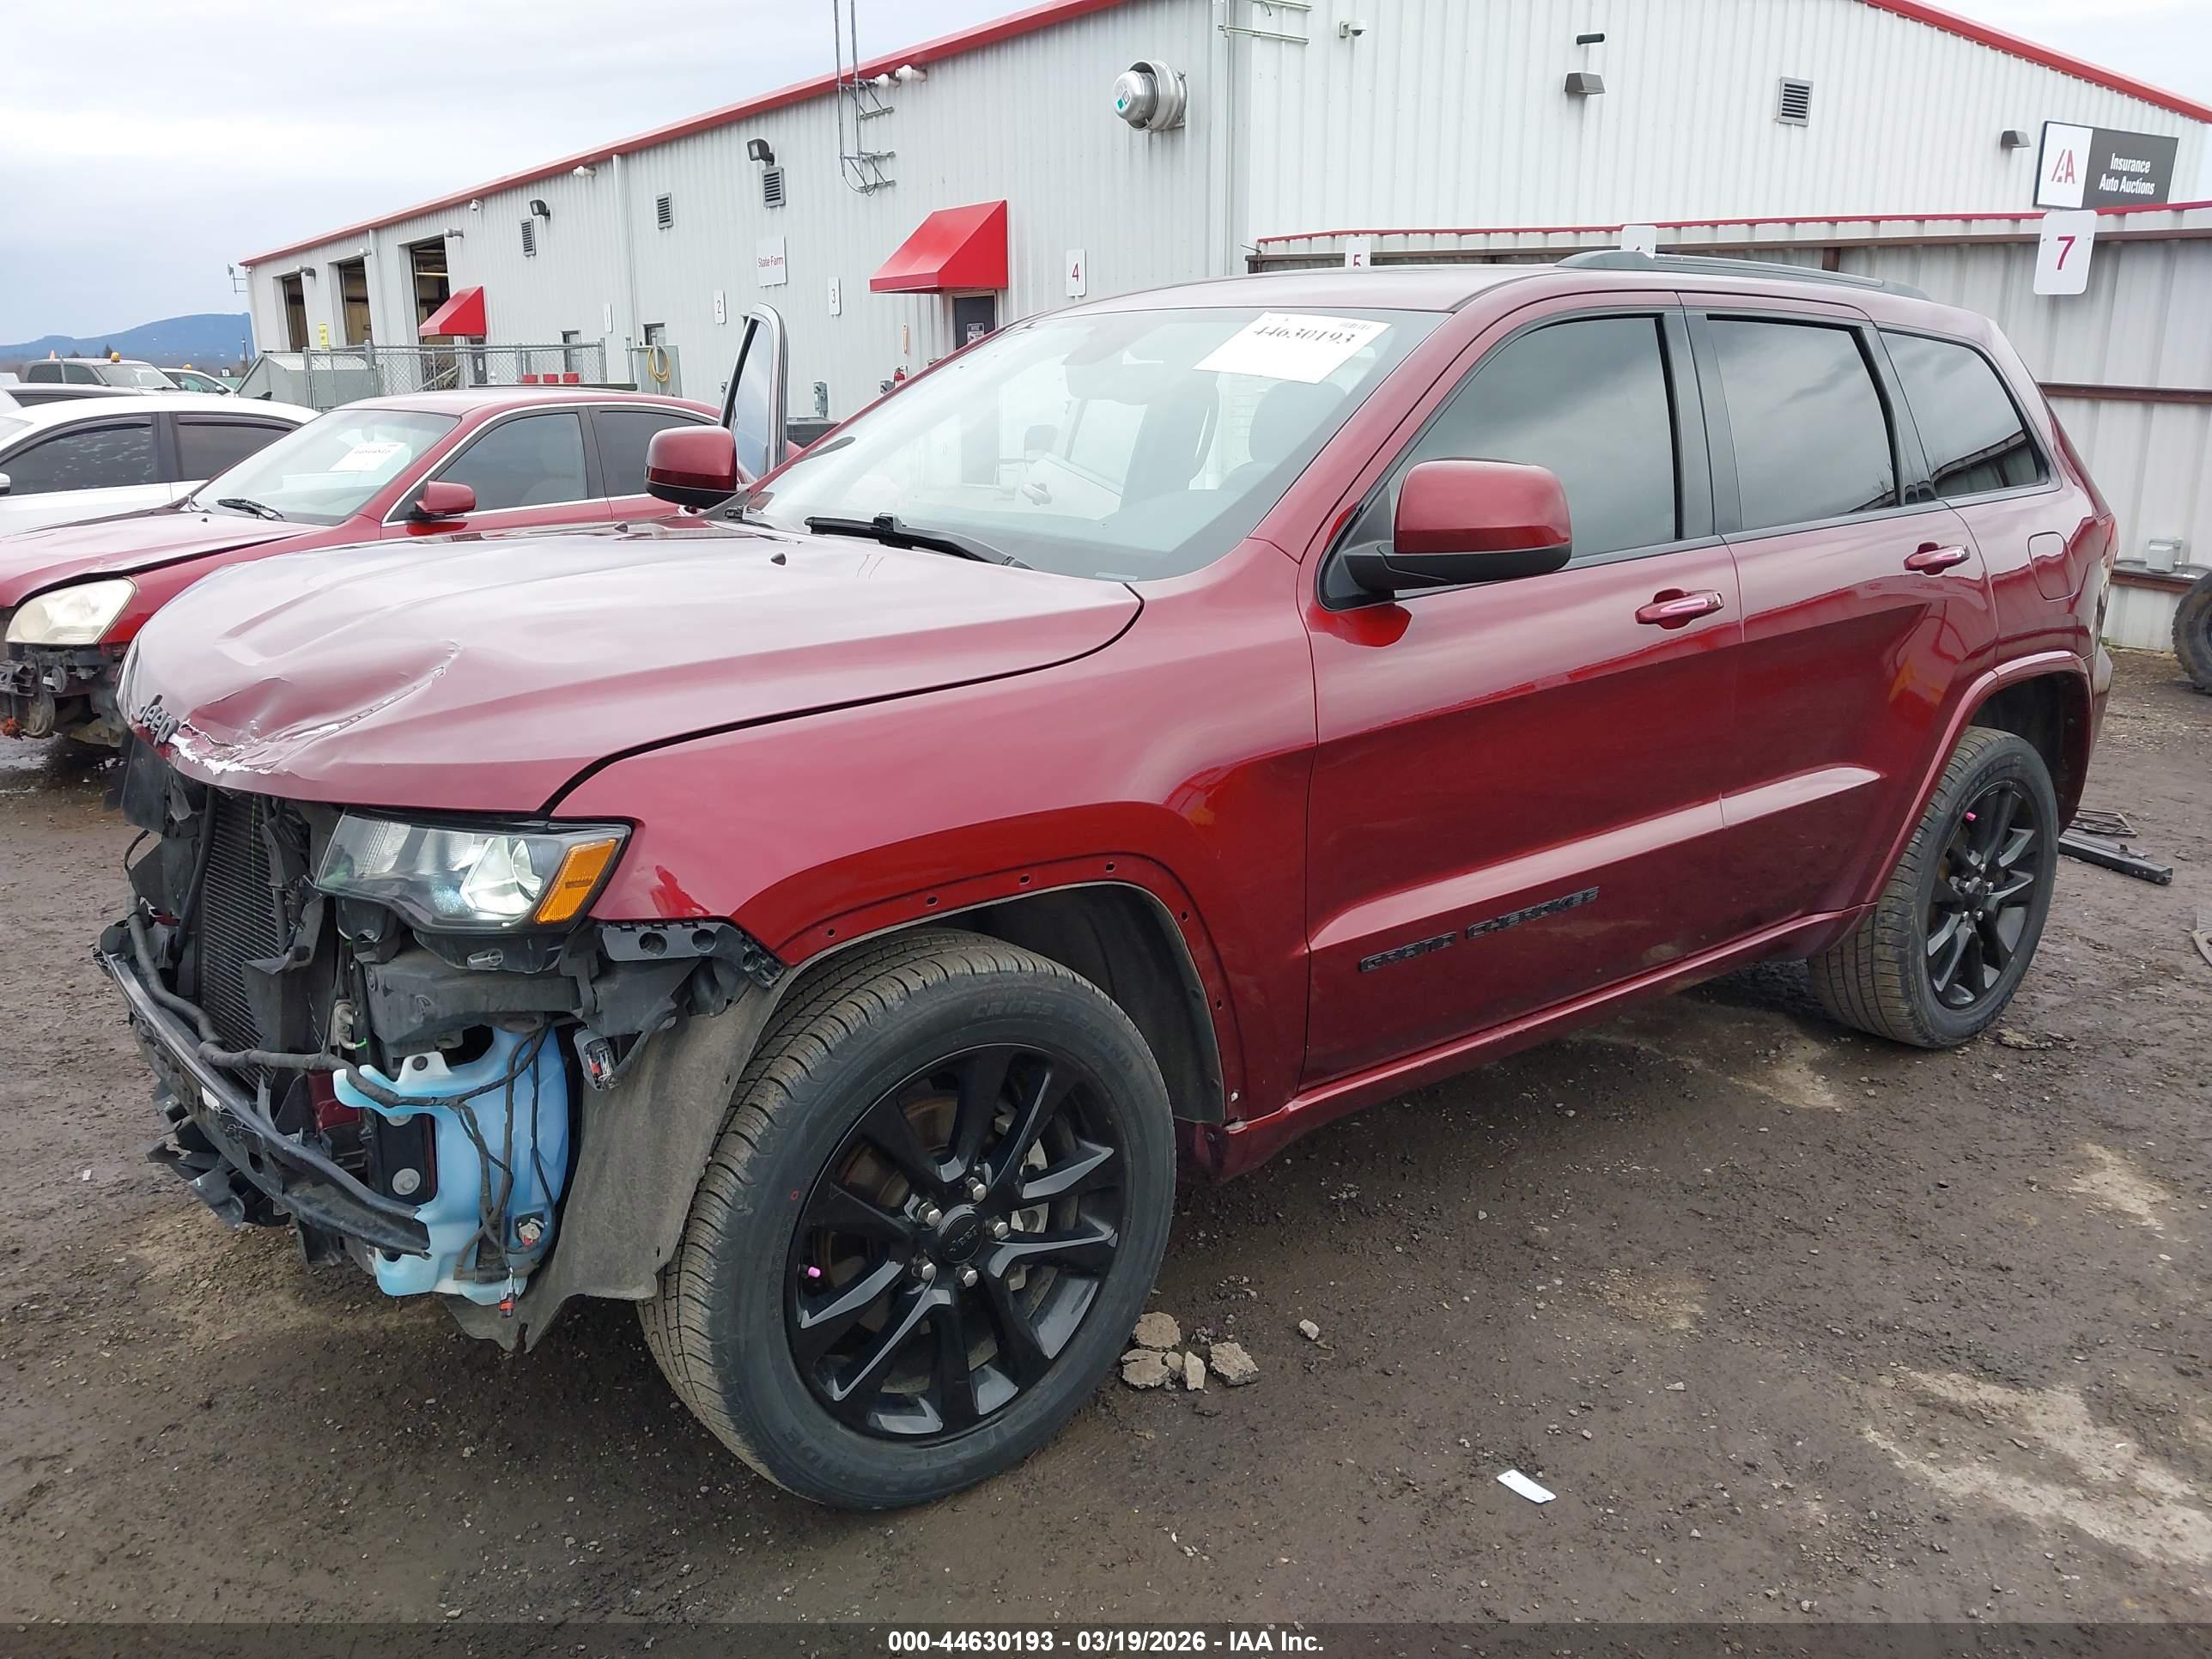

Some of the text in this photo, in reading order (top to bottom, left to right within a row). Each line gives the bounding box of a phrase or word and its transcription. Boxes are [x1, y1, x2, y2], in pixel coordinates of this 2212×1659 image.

[2110, 152, 2151, 174] Insurance
[2099, 173, 2155, 196] Auto Auctions
[757, 255, 784, 268] State Farm
[2057, 235, 2076, 270] 7
[1072, 263, 1079, 283] 4
[716, 300, 722, 314] 2
[831, 289, 836, 304] 3
[137, 694, 179, 748] Jeep
